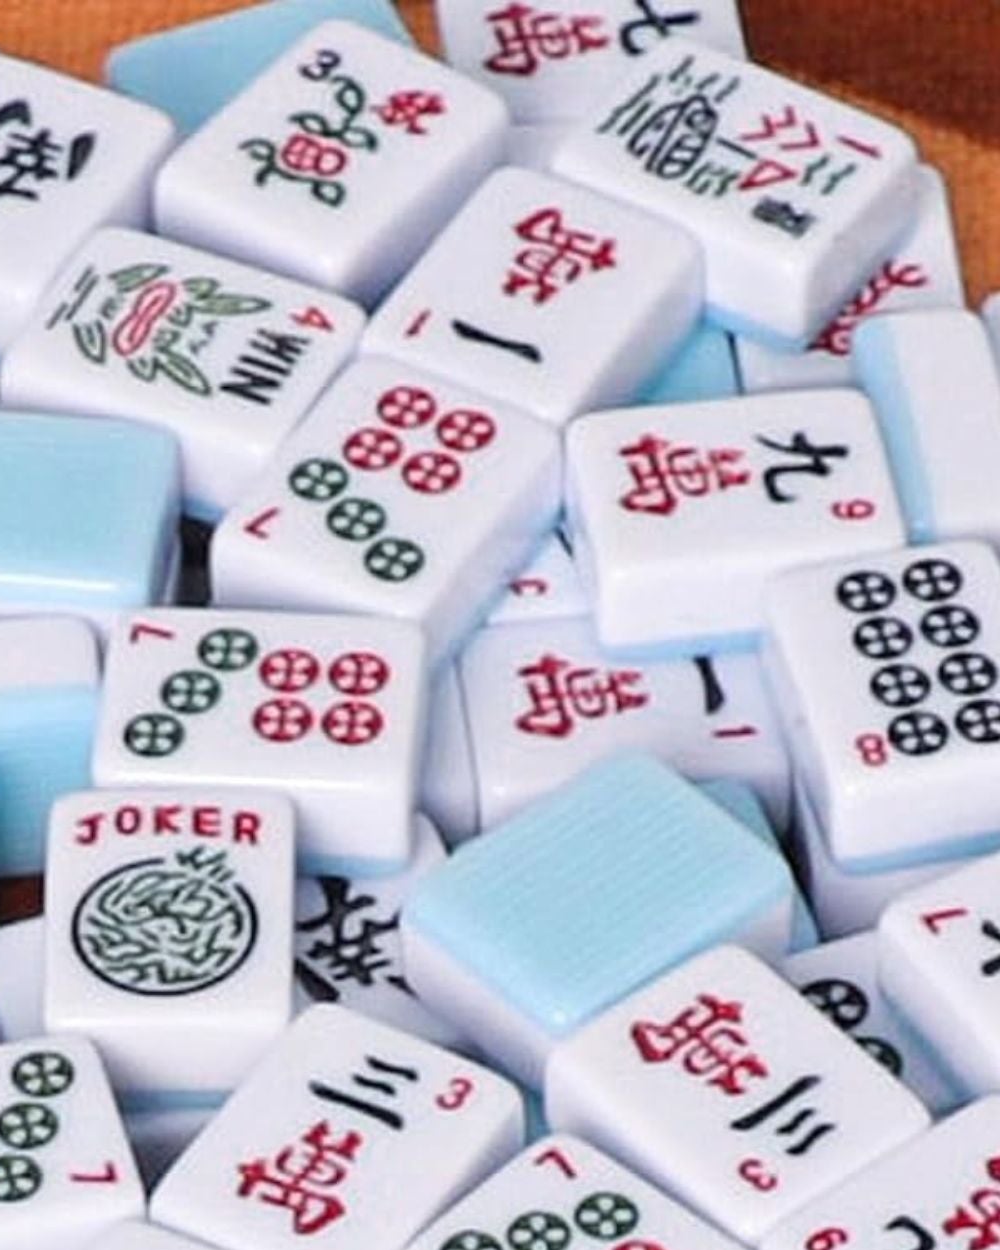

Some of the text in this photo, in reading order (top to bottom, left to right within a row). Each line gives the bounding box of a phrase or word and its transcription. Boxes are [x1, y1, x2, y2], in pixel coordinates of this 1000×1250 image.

[299, 50, 342, 82] 3
[220, 307, 333, 405] 4 WIN
[244, 508, 279, 539] 7
[130, 624, 174, 644] 7
[855, 732, 888, 767] 8
[74, 805, 261, 846] JOKER
[920, 908, 968, 935] 7
[436, 1078, 473, 1110] 3
[70, 1162, 118, 1184] 7
[534, 1148, 577, 1180] 7
[738, 1159, 778, 1192] 3
